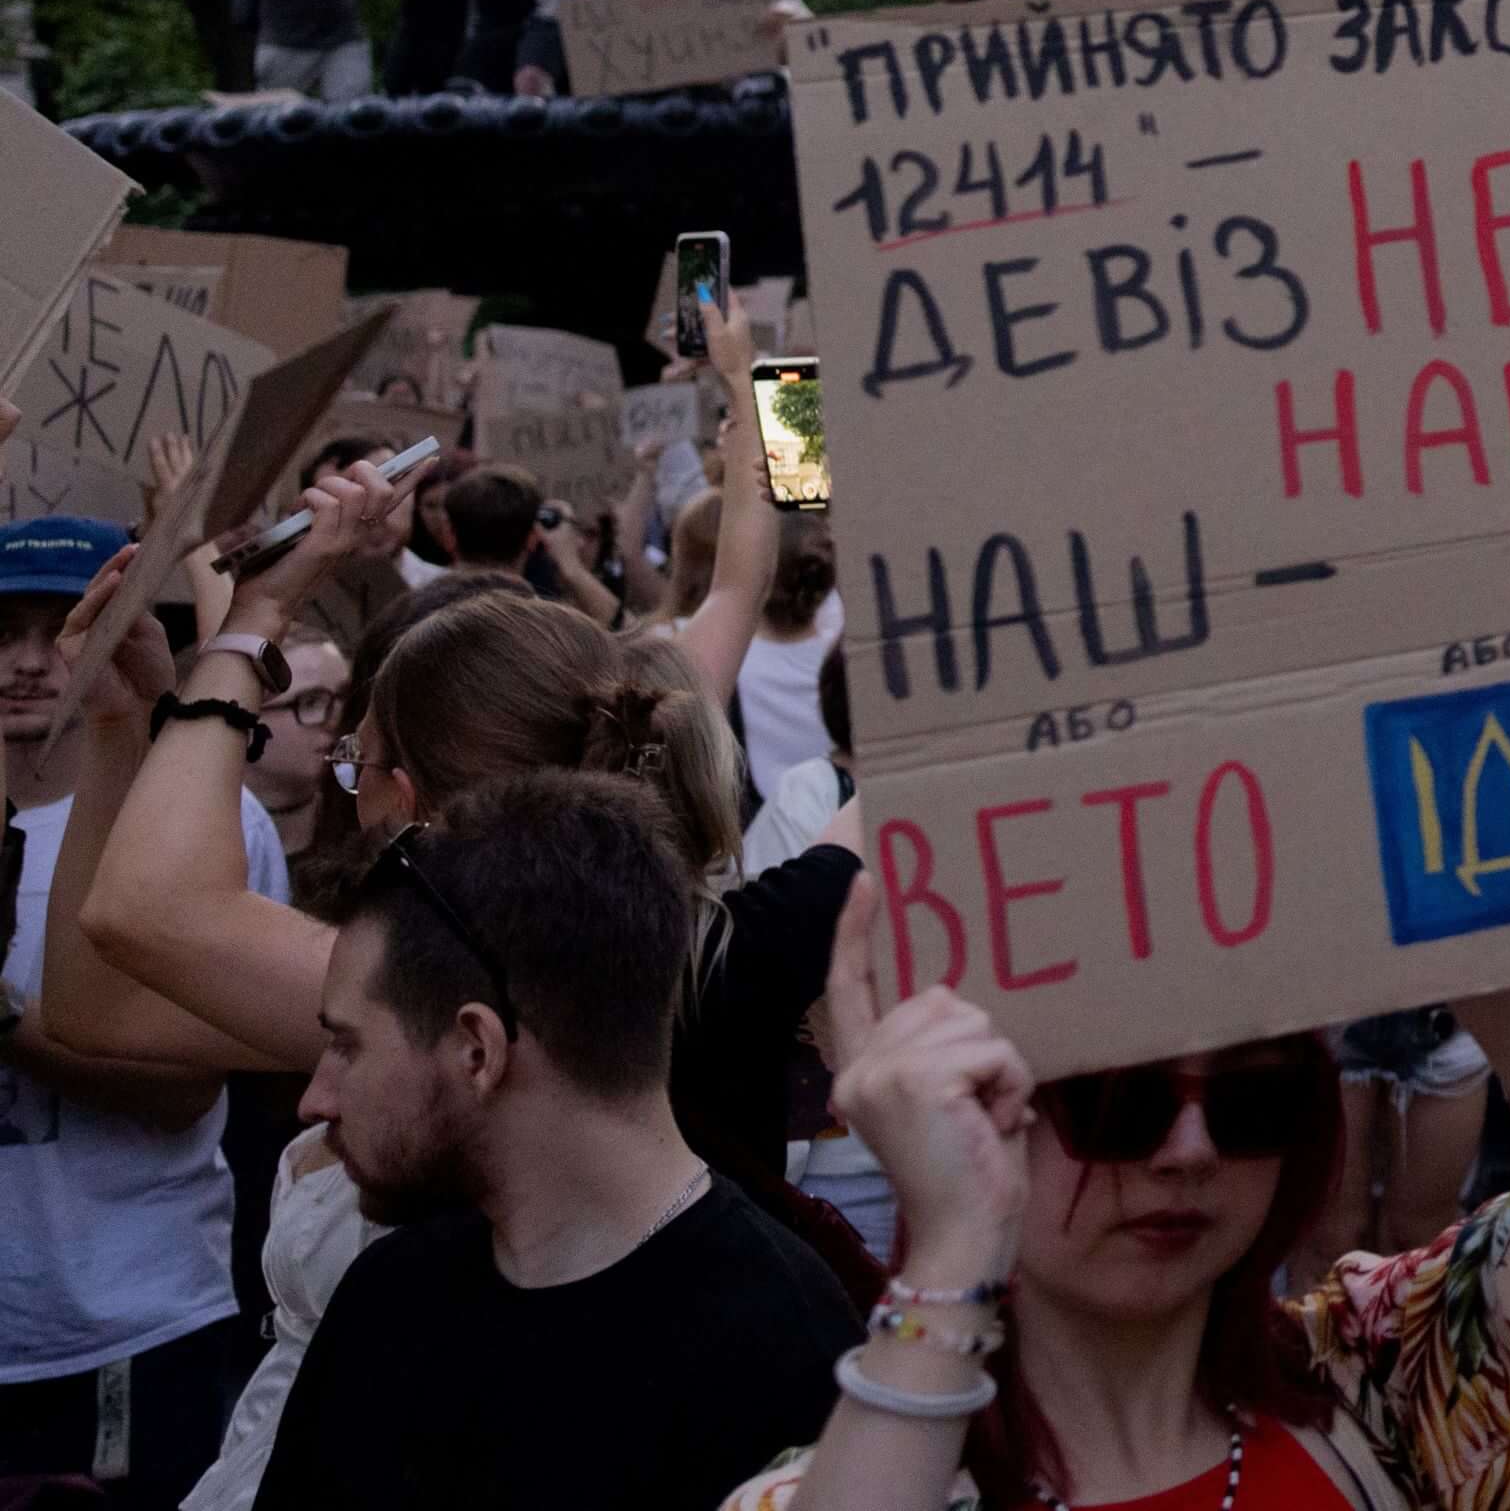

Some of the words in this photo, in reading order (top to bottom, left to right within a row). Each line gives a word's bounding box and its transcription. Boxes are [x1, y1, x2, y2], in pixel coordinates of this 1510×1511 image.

[868, 509, 1212, 702] НАШ
[1025, 698, 1137, 753] АБО
[878, 758, 1276, 1001] ВЕТО
